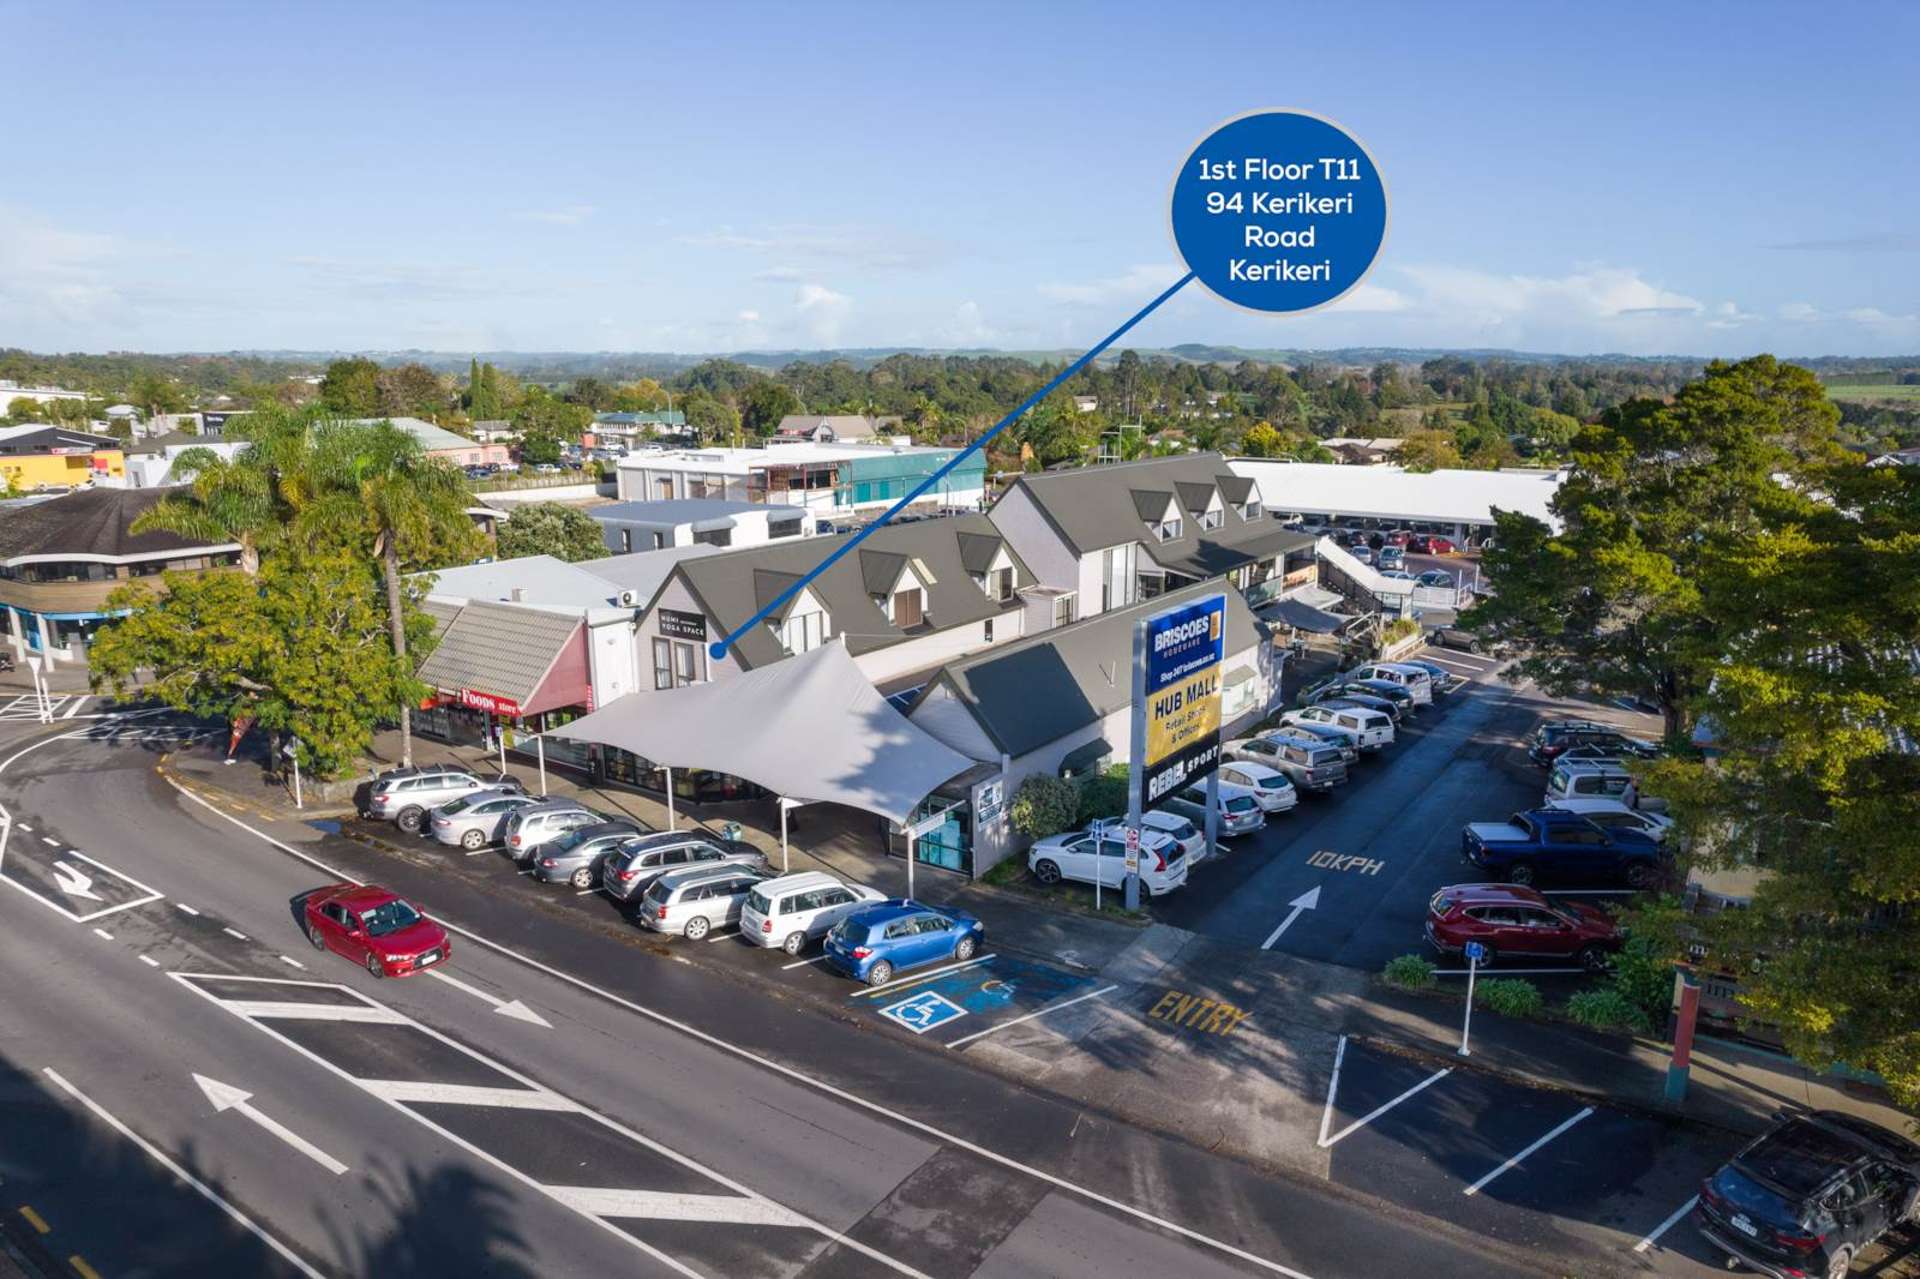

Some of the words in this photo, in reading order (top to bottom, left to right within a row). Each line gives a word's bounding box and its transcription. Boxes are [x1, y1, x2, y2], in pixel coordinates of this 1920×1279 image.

[1154, 616, 1209, 652] BRISCOES
[498, 702, 517, 714] store
[1155, 691, 1183, 720] HUB
[1186, 674, 1217, 705] MALL
[1187, 744, 1219, 774] SPORT
[1305, 850, 1385, 876] 10KPH
[1148, 990, 1252, 1037] ENTRY
